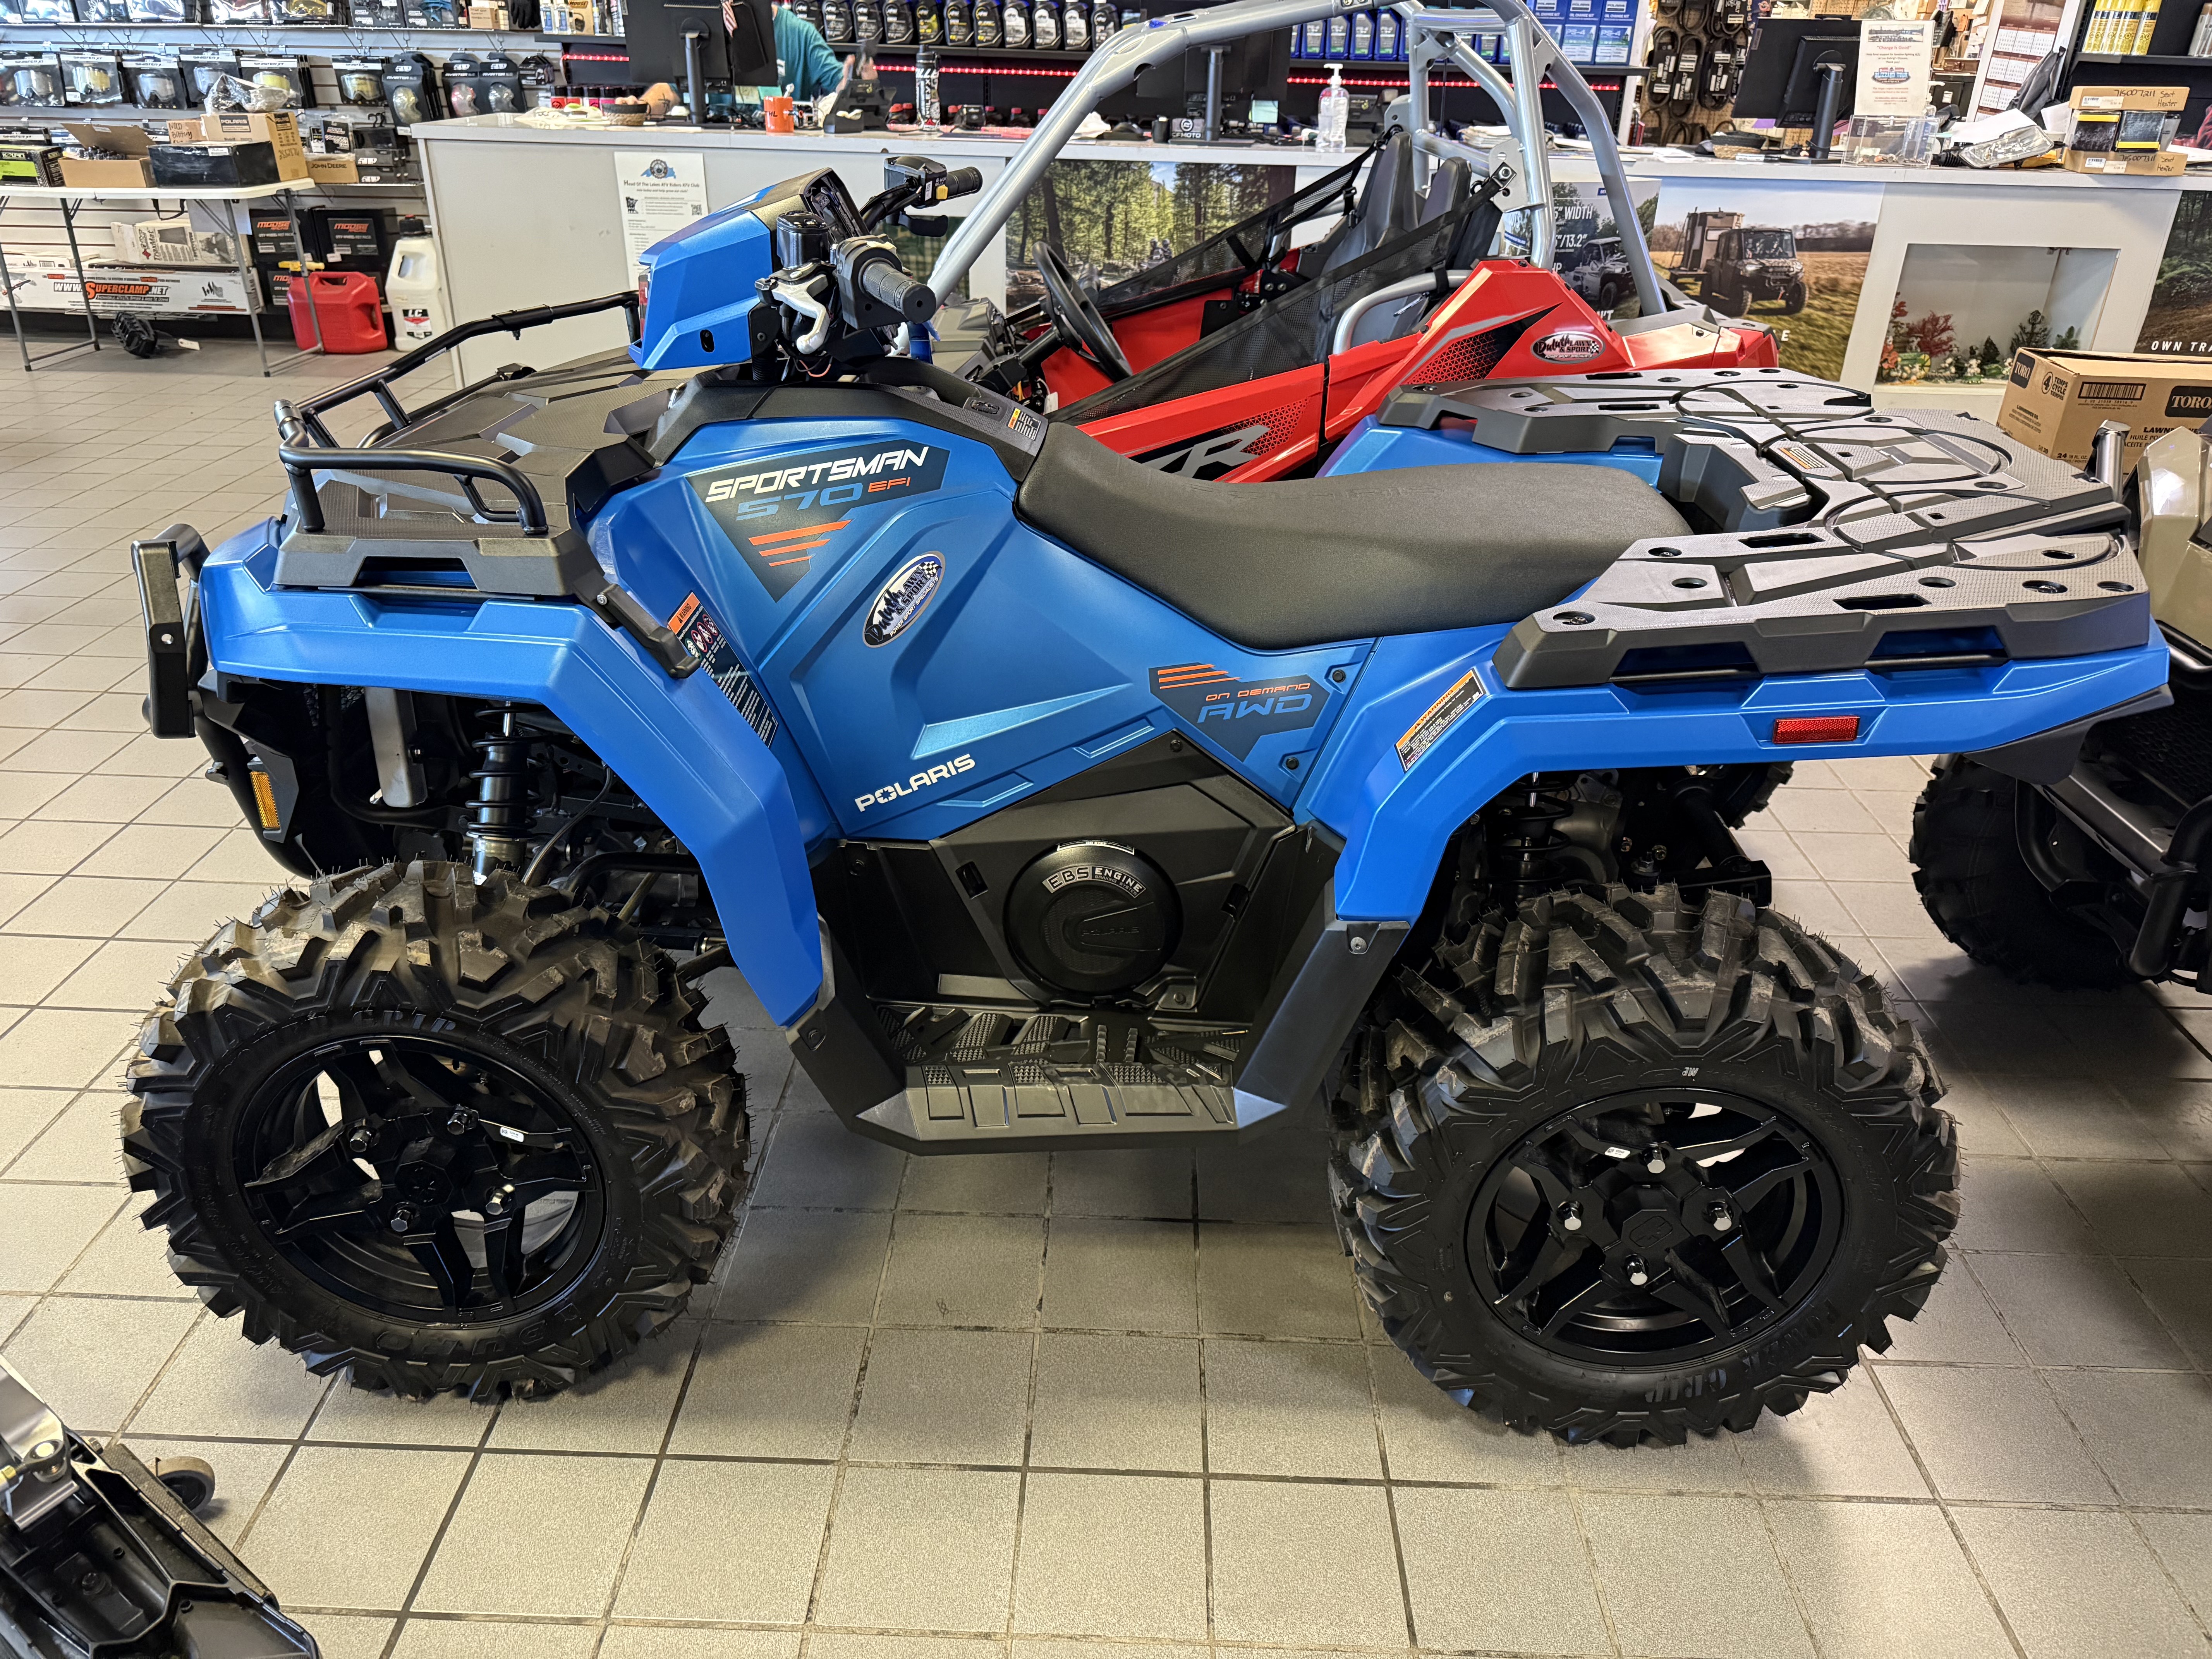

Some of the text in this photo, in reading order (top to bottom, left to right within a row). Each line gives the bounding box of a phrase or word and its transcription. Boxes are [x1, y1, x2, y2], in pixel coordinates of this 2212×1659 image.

[1565, 206, 1594, 220] WIDTH
[1537, 333, 1570, 354] Duluth
[2151, 341, 2183, 351] OWN
[2015, 362, 2030, 379] TORO
[2043, 376, 2068, 391] 4 TEMPS
[2052, 383, 2066, 395] CYCLE
[706, 447, 929, 503] SPORTSMAN
[736, 477, 911, 520] 570 EFI
[864, 566, 925, 642] Duluth LAWN
[890, 575, 939, 637] POWER SPORT SPECIALISTS
[895, 573, 931, 616] & SPORT
[680, 603, 692, 619] WARNING
[1206, 683, 1310, 701] ON DEMAND
[1197, 694, 1312, 723] AWD
[1420, 689, 1454, 721] WARNING
[854, 753, 975, 812] POLARIS
[1047, 866, 1143, 893] EBS ENGINE
[1095, 875, 1117, 883] BRAKING
